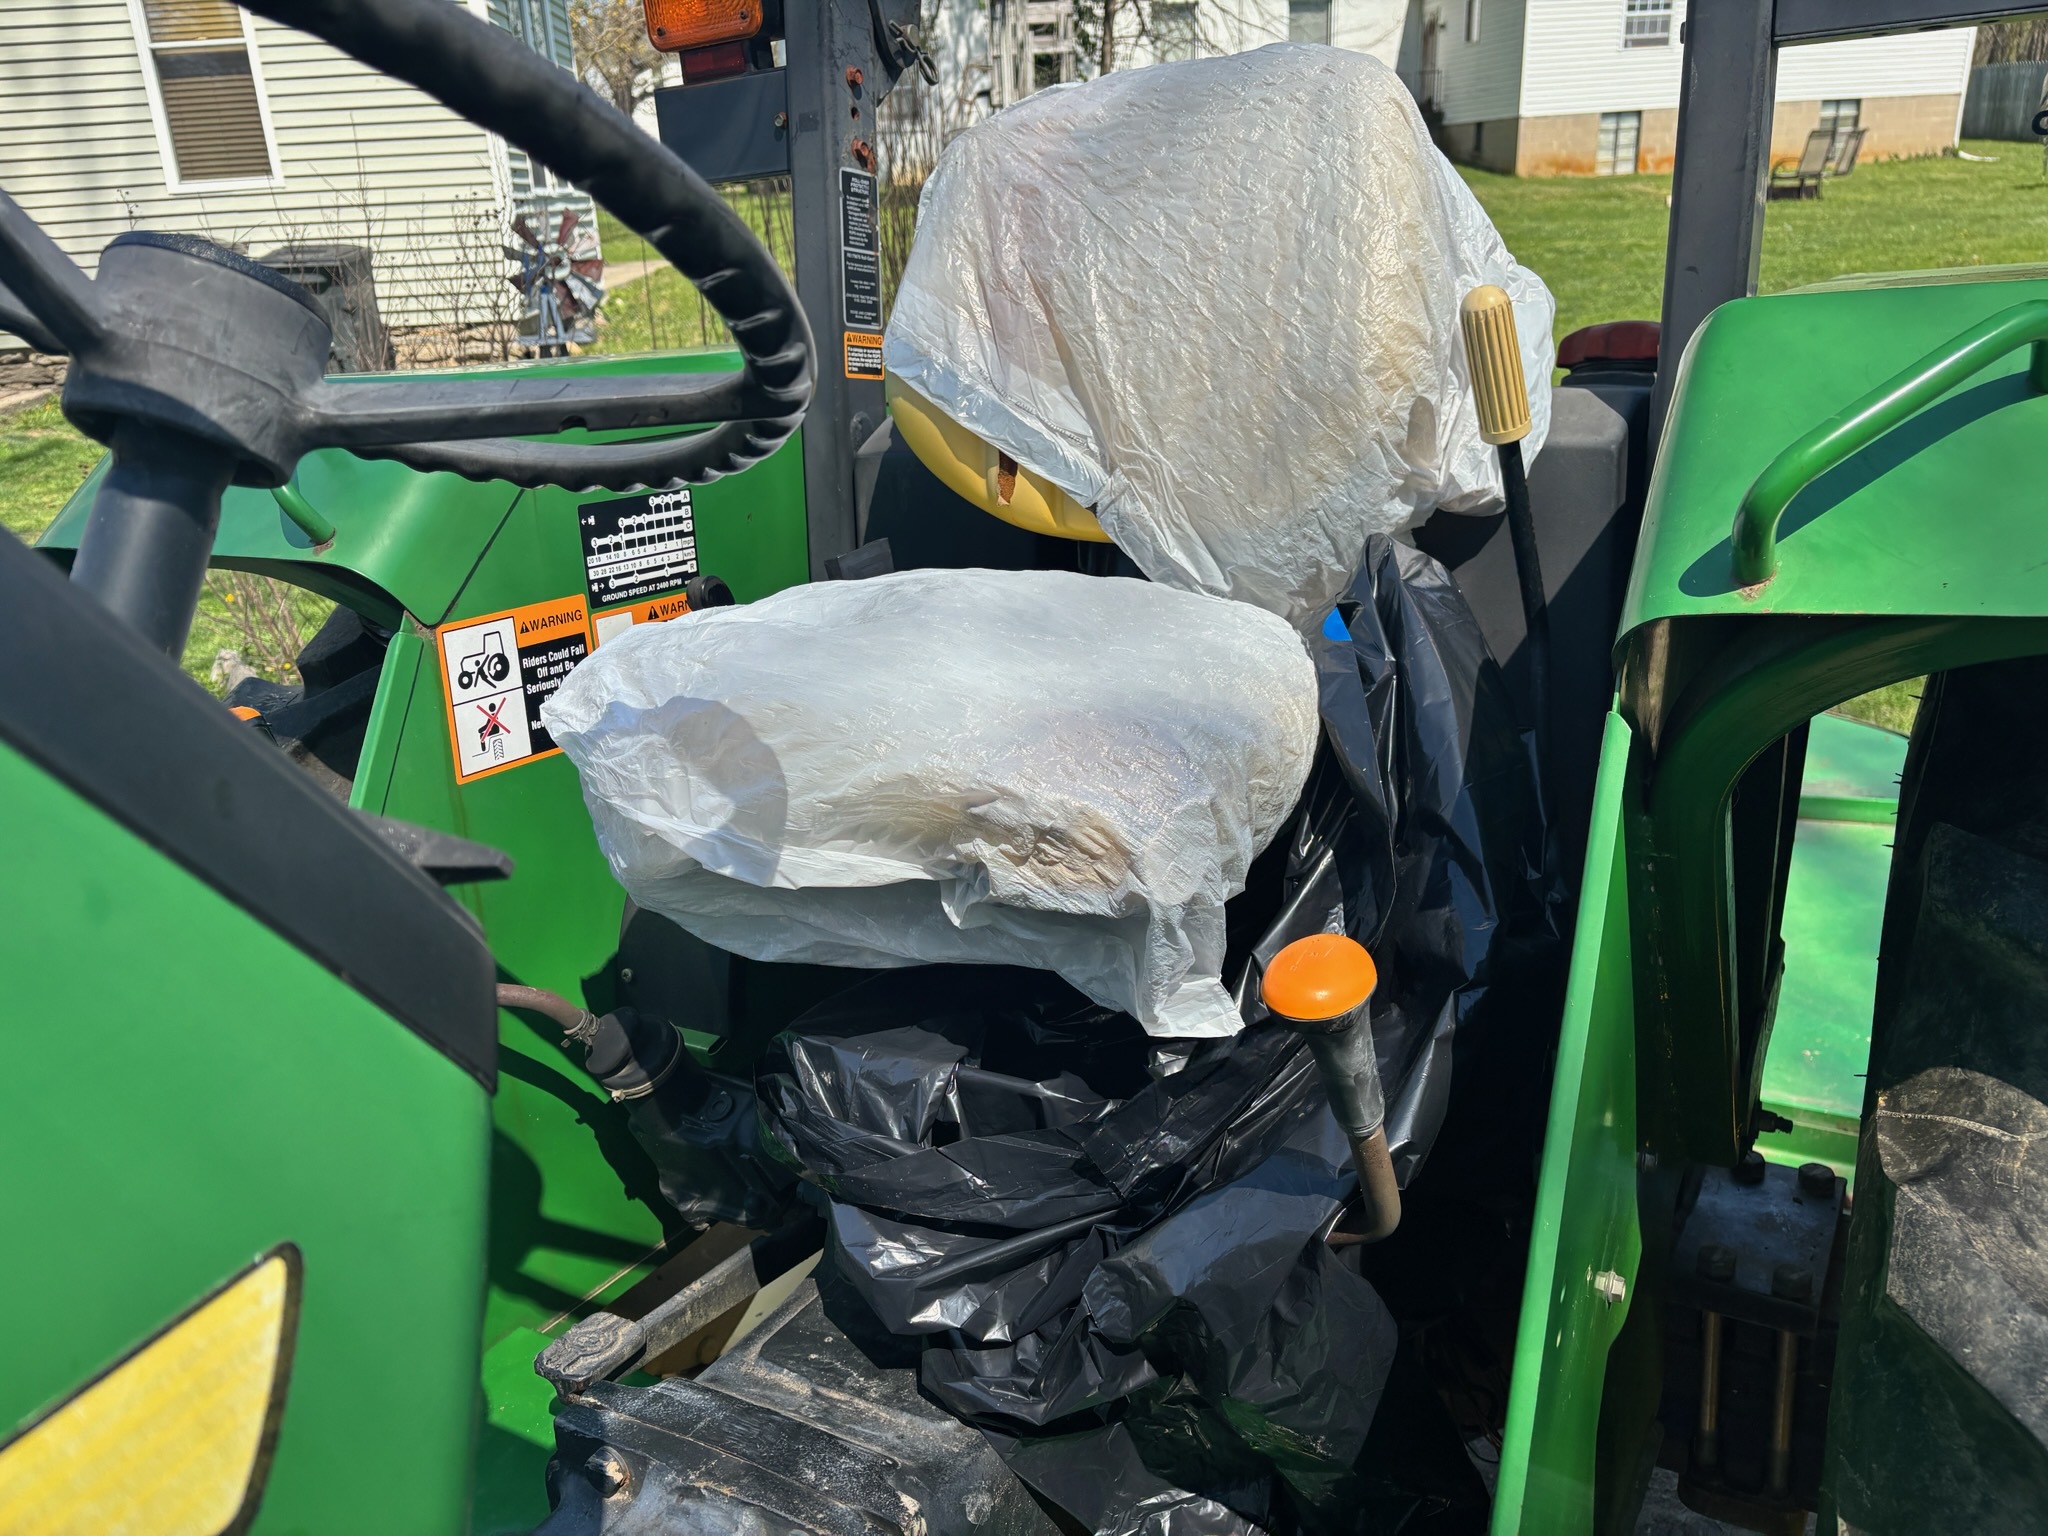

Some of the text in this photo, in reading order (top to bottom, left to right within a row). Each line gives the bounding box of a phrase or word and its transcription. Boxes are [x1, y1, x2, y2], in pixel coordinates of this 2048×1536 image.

[661, 496, 665, 504] 2
[606, 553, 612, 561] 14
[682, 538, 694, 546] mph
[602, 590, 628, 602] GROUND
[629, 585, 648, 596] SPEED
[649, 583, 655, 591] AT
[657, 580, 669, 590] 2400
[670, 578, 682, 586] RPM
[611, 580, 615, 588] 3
[659, 600, 691, 616] WARN
[529, 610, 582, 631] WARNING
[522, 643, 585, 669] Riders Could Fall
[537, 666, 548, 679] Off
[550, 663, 563, 675] and
[565, 660, 574, 670] Be
[526, 676, 562, 695] Seriously
[531, 719, 545, 731] Nev
